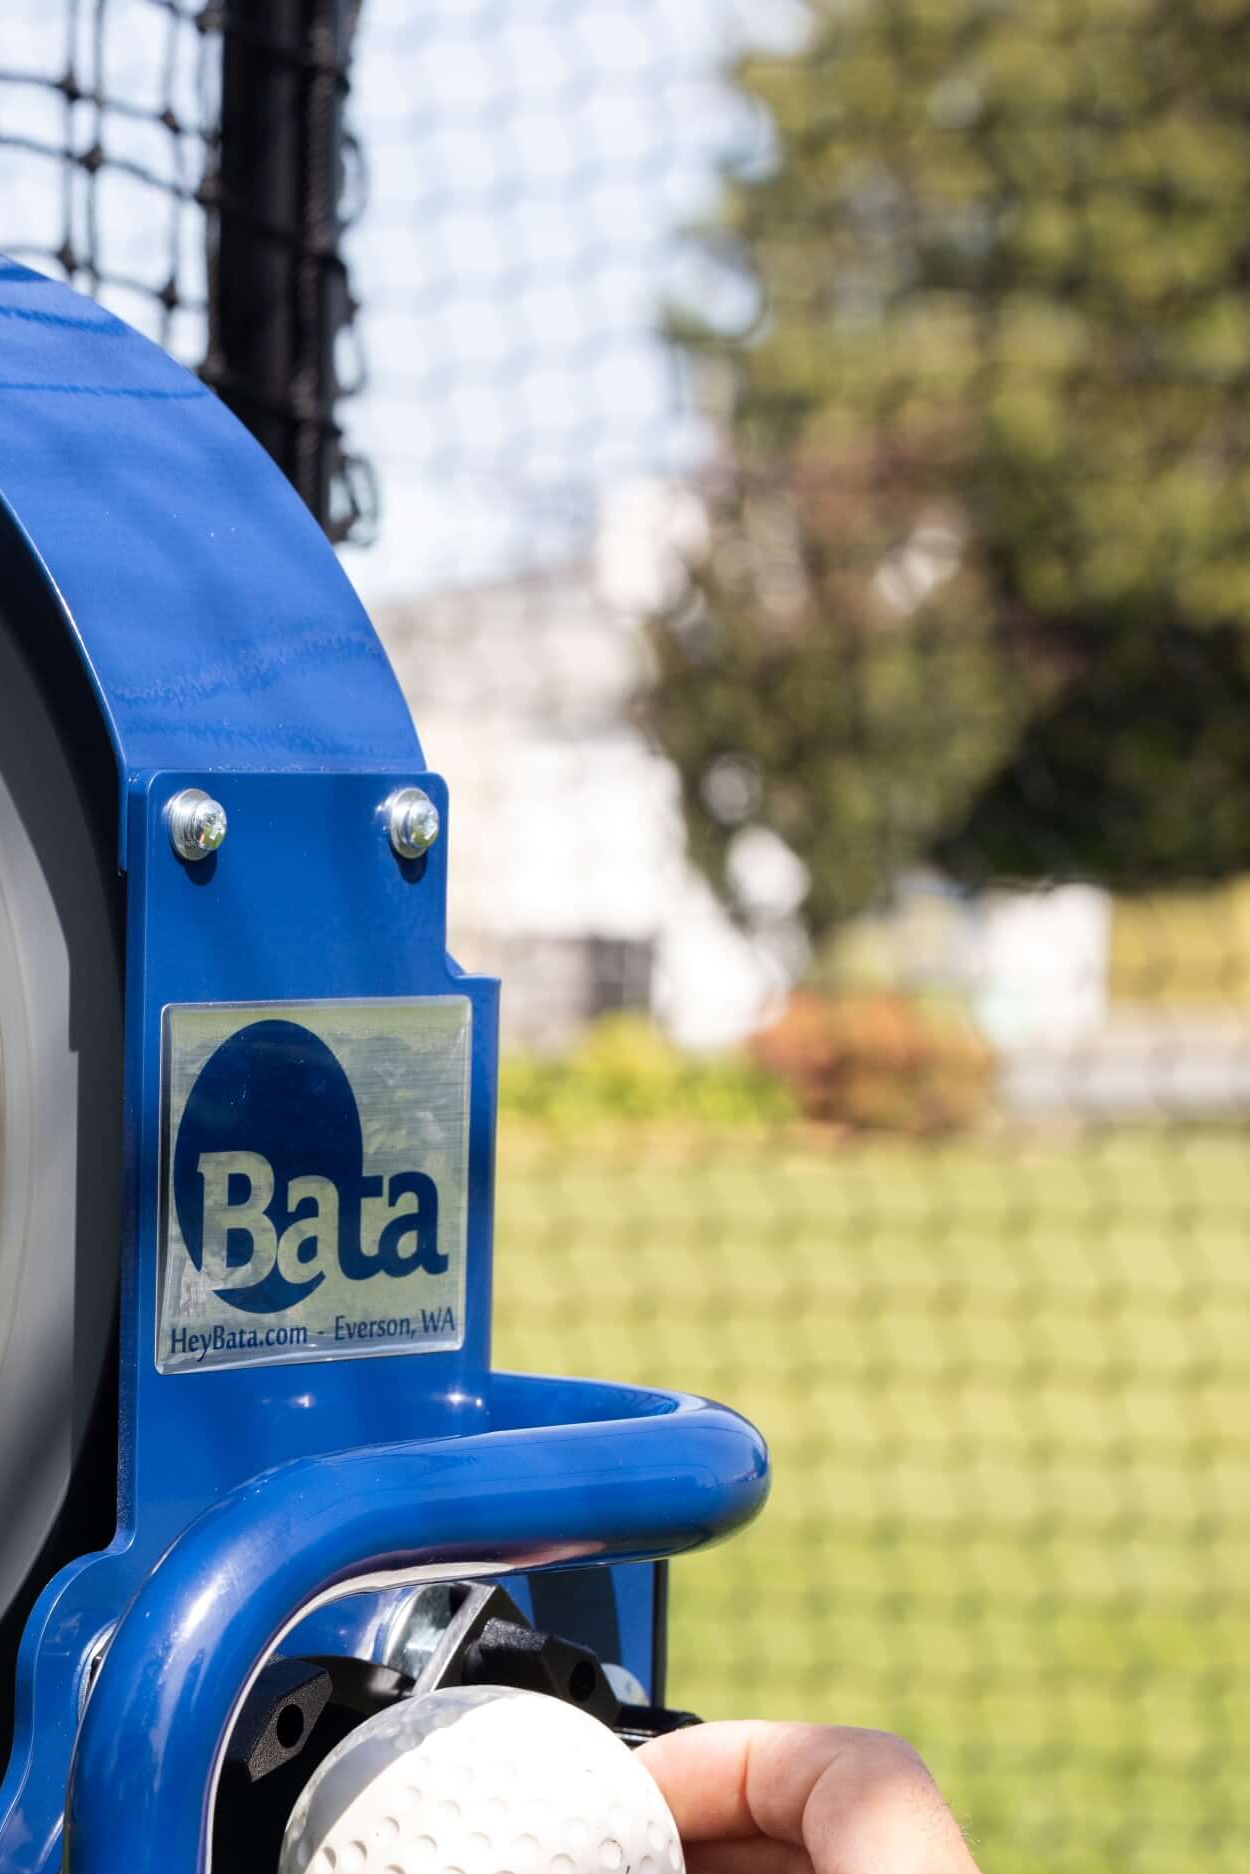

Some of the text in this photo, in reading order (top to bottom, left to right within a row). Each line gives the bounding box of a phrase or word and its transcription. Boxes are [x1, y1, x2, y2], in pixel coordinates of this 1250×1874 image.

[196, 1149, 449, 1286] Bata
[170, 1324, 308, 1362] HeyBata.com
[334, 1312, 417, 1342] Everson,
[421, 1307, 456, 1334] WA
